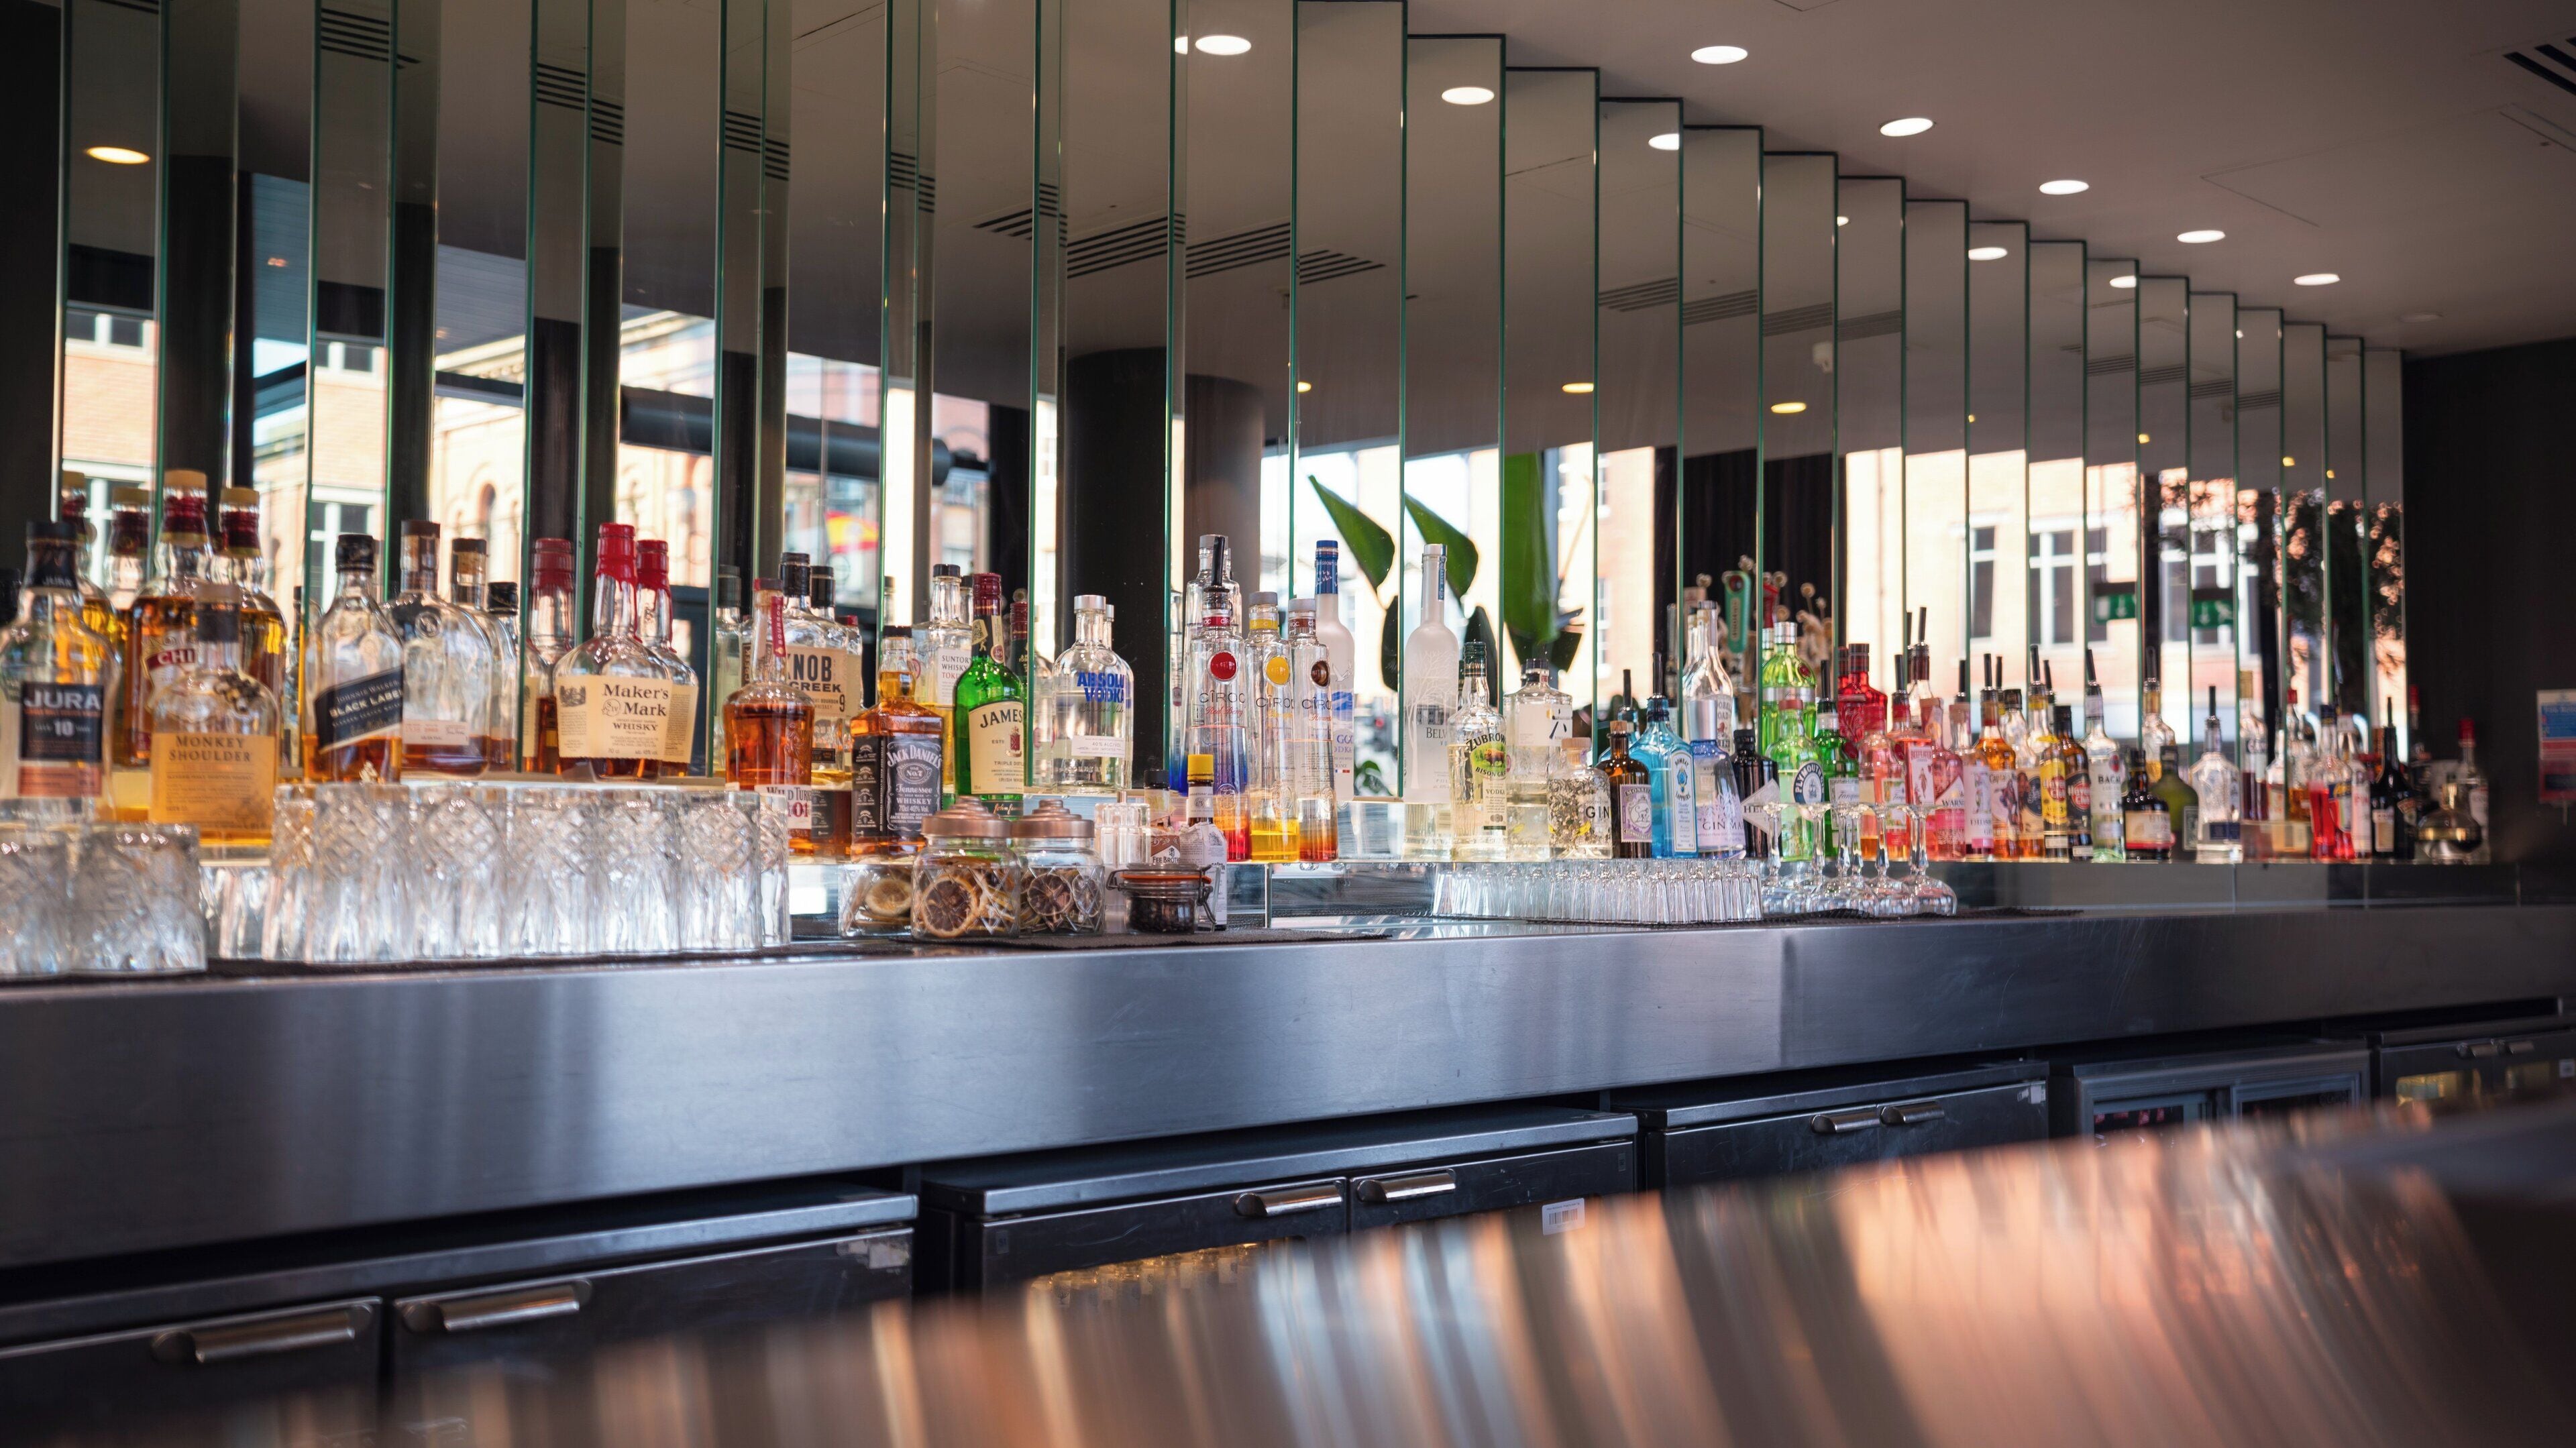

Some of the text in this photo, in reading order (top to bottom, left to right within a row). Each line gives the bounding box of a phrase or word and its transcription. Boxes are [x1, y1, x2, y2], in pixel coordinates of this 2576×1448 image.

[602, 683, 669, 700] Maker's
[23, 689, 101, 710] JURA
[839, 693, 846, 713] 9
[328, 699, 368, 718] BLACK
[623, 702, 667, 717] Mark
[54, 719, 75, 737] 10
[612, 722, 658, 731] WHISKY
[176, 735, 244, 748] MONKEY
[168, 748, 252, 763] SHOULDER
[887, 744, 943, 769] JACK DANIEL'S
[1476, 767, 1497, 777] BISON
[1794, 763, 1821, 793] PLYMOUTH
[896, 783, 932, 794] Tennessee
[910, 805, 920, 813] 40%
[1585, 805, 1610, 819] GIN
[1702, 821, 1726, 831] GIN
